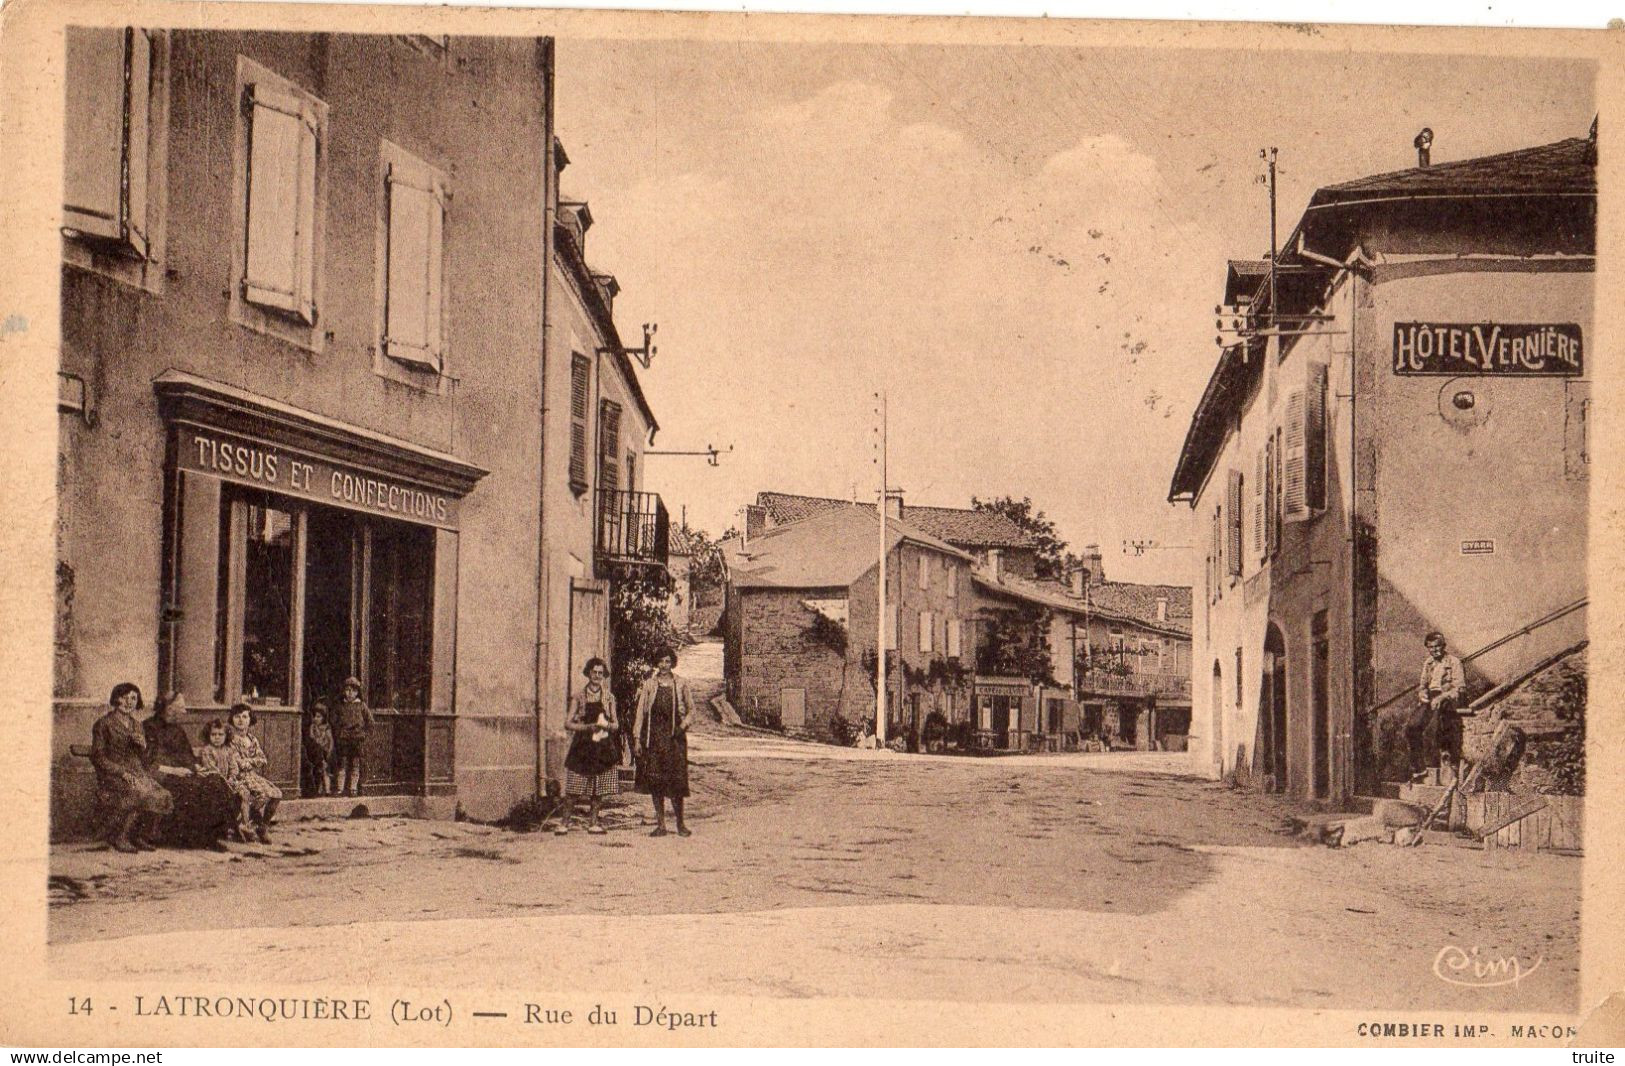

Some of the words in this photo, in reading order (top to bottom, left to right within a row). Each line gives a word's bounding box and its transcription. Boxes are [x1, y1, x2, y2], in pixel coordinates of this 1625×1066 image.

[1396, 325, 1477, 370] HÔTEL
[194, 437, 278, 482] TISSUS
[291, 461, 313, 493] ET
[330, 471, 446, 520] CONFECTIONS
